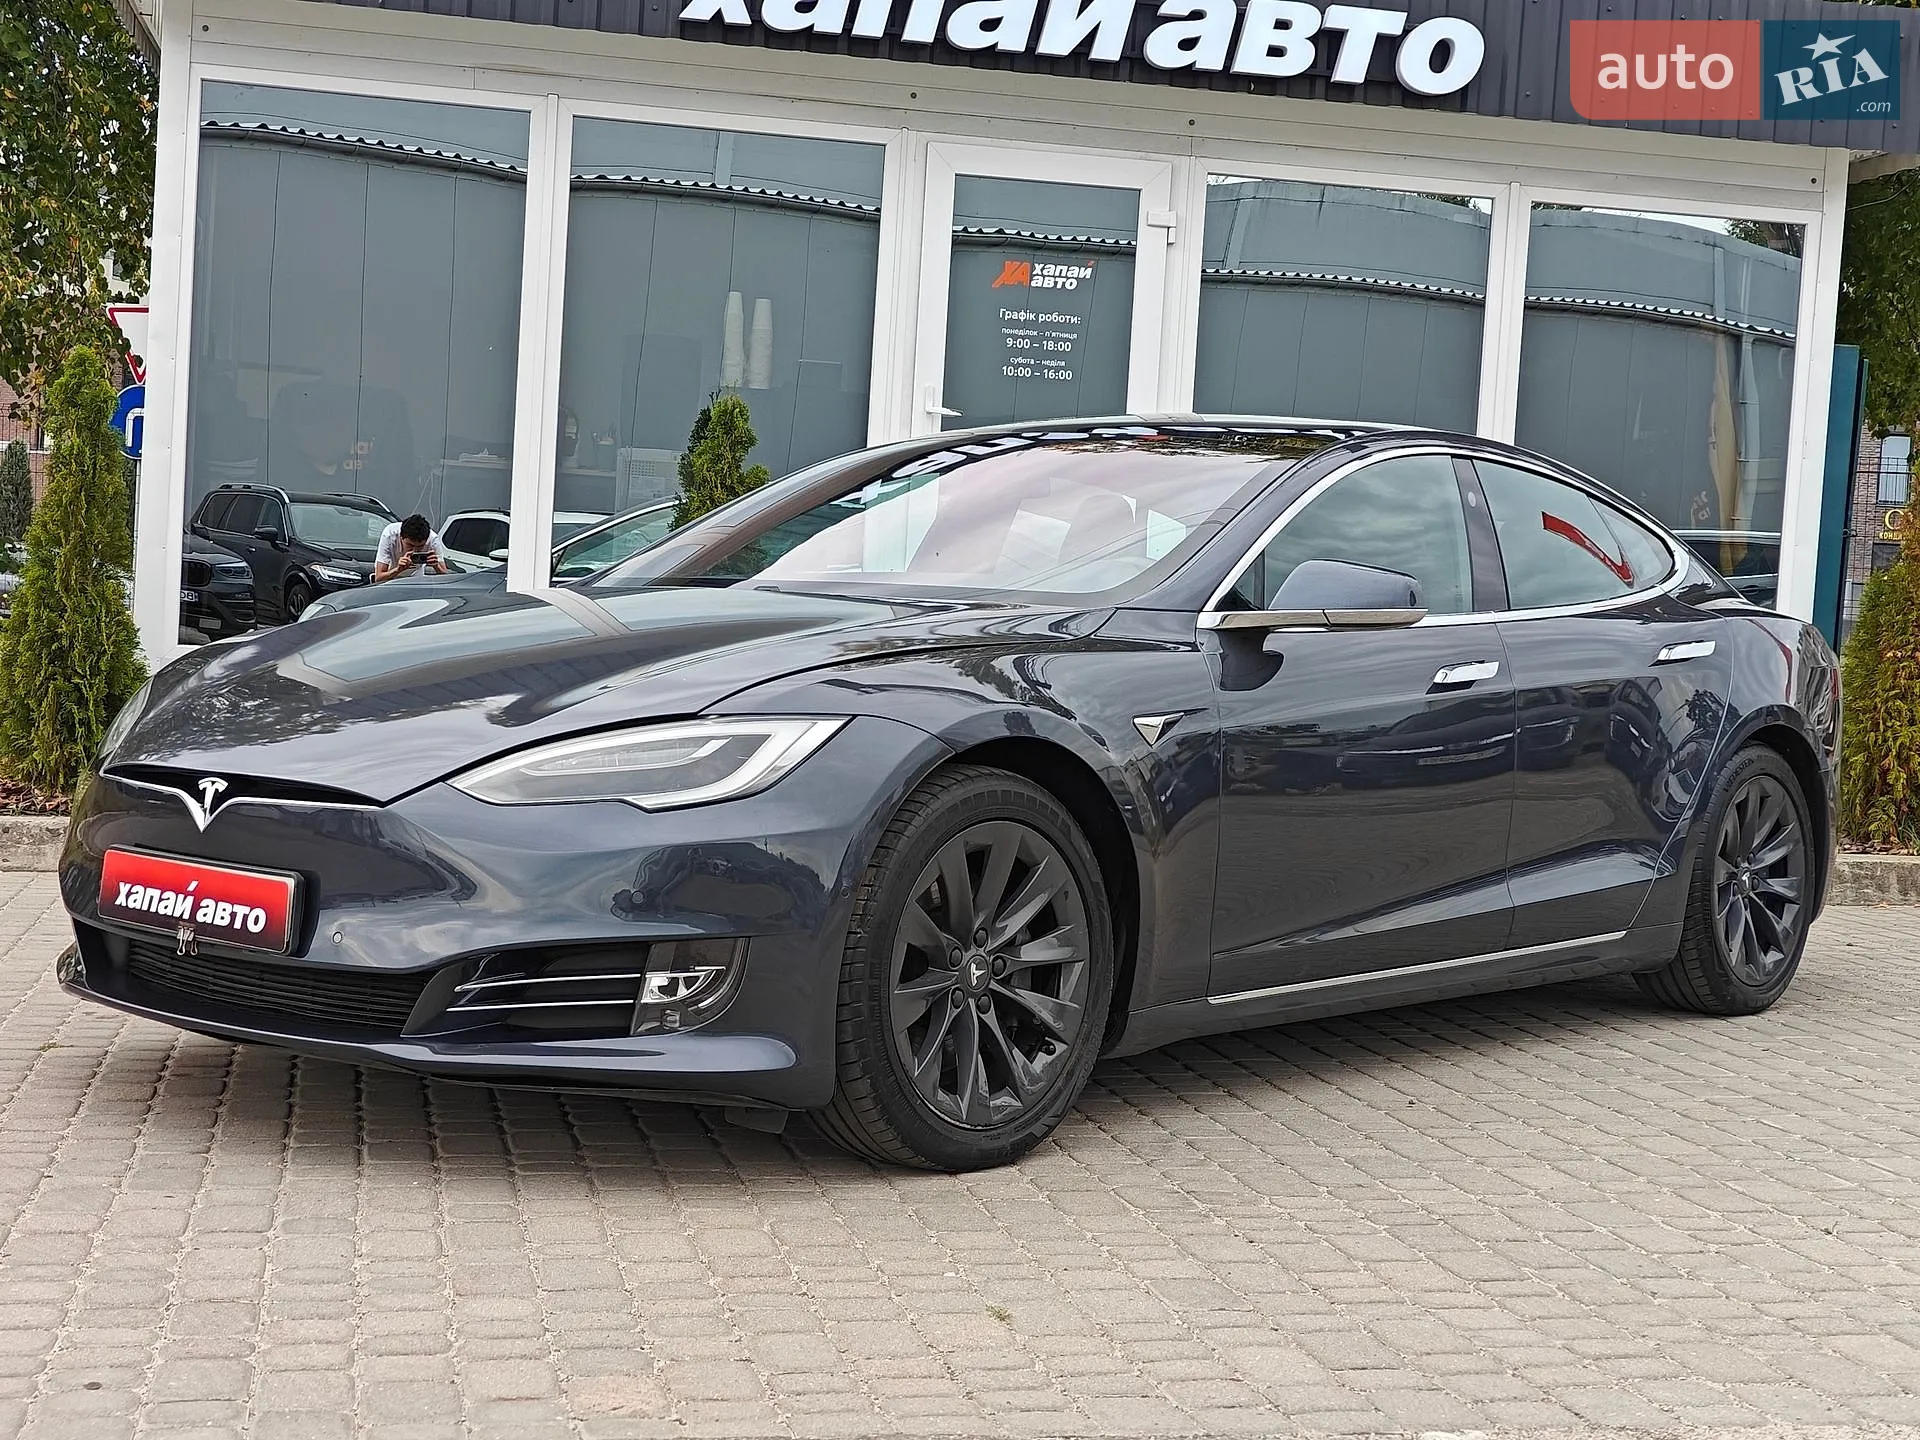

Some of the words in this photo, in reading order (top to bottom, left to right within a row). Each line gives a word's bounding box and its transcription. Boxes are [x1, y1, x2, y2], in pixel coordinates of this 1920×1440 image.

[1031, 276, 1078, 290] авто
[999, 308, 1036, 322] Графік
[1038, 312, 1081, 324] роботи:
[1001, 328, 1038, 336] понеділок
[1006, 337, 1030, 349] 9:00
[1042, 340, 1072, 351] 18:00
[1010, 357, 1035, 365] субота
[1042, 359, 1066, 367] неділя
[1001, 366, 1031, 377] 10:00
[1043, 369, 1072, 380] 16:00
[114, 880, 199, 920] хапай
[195, 898, 267, 934] авто
